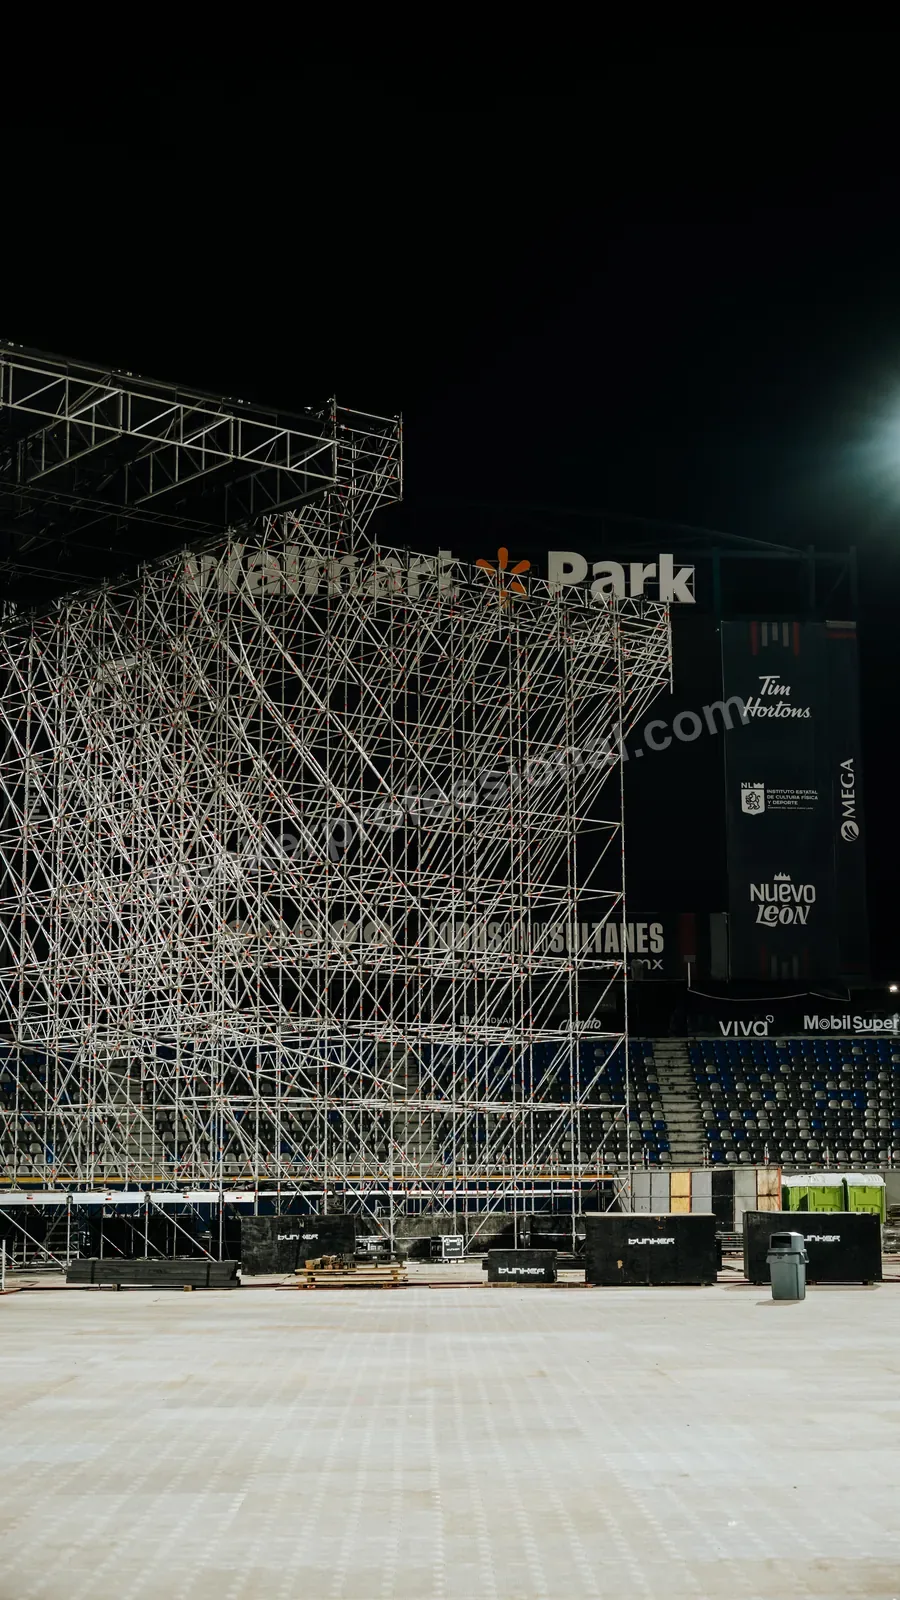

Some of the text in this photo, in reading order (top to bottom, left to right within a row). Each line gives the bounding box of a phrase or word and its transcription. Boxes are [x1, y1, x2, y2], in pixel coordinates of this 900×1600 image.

[548, 551, 696, 603] Park
[759, 675, 791, 696] Tim
[743, 696, 811, 718] Hortons
[804, 1015, 850, 1030] Mobil
